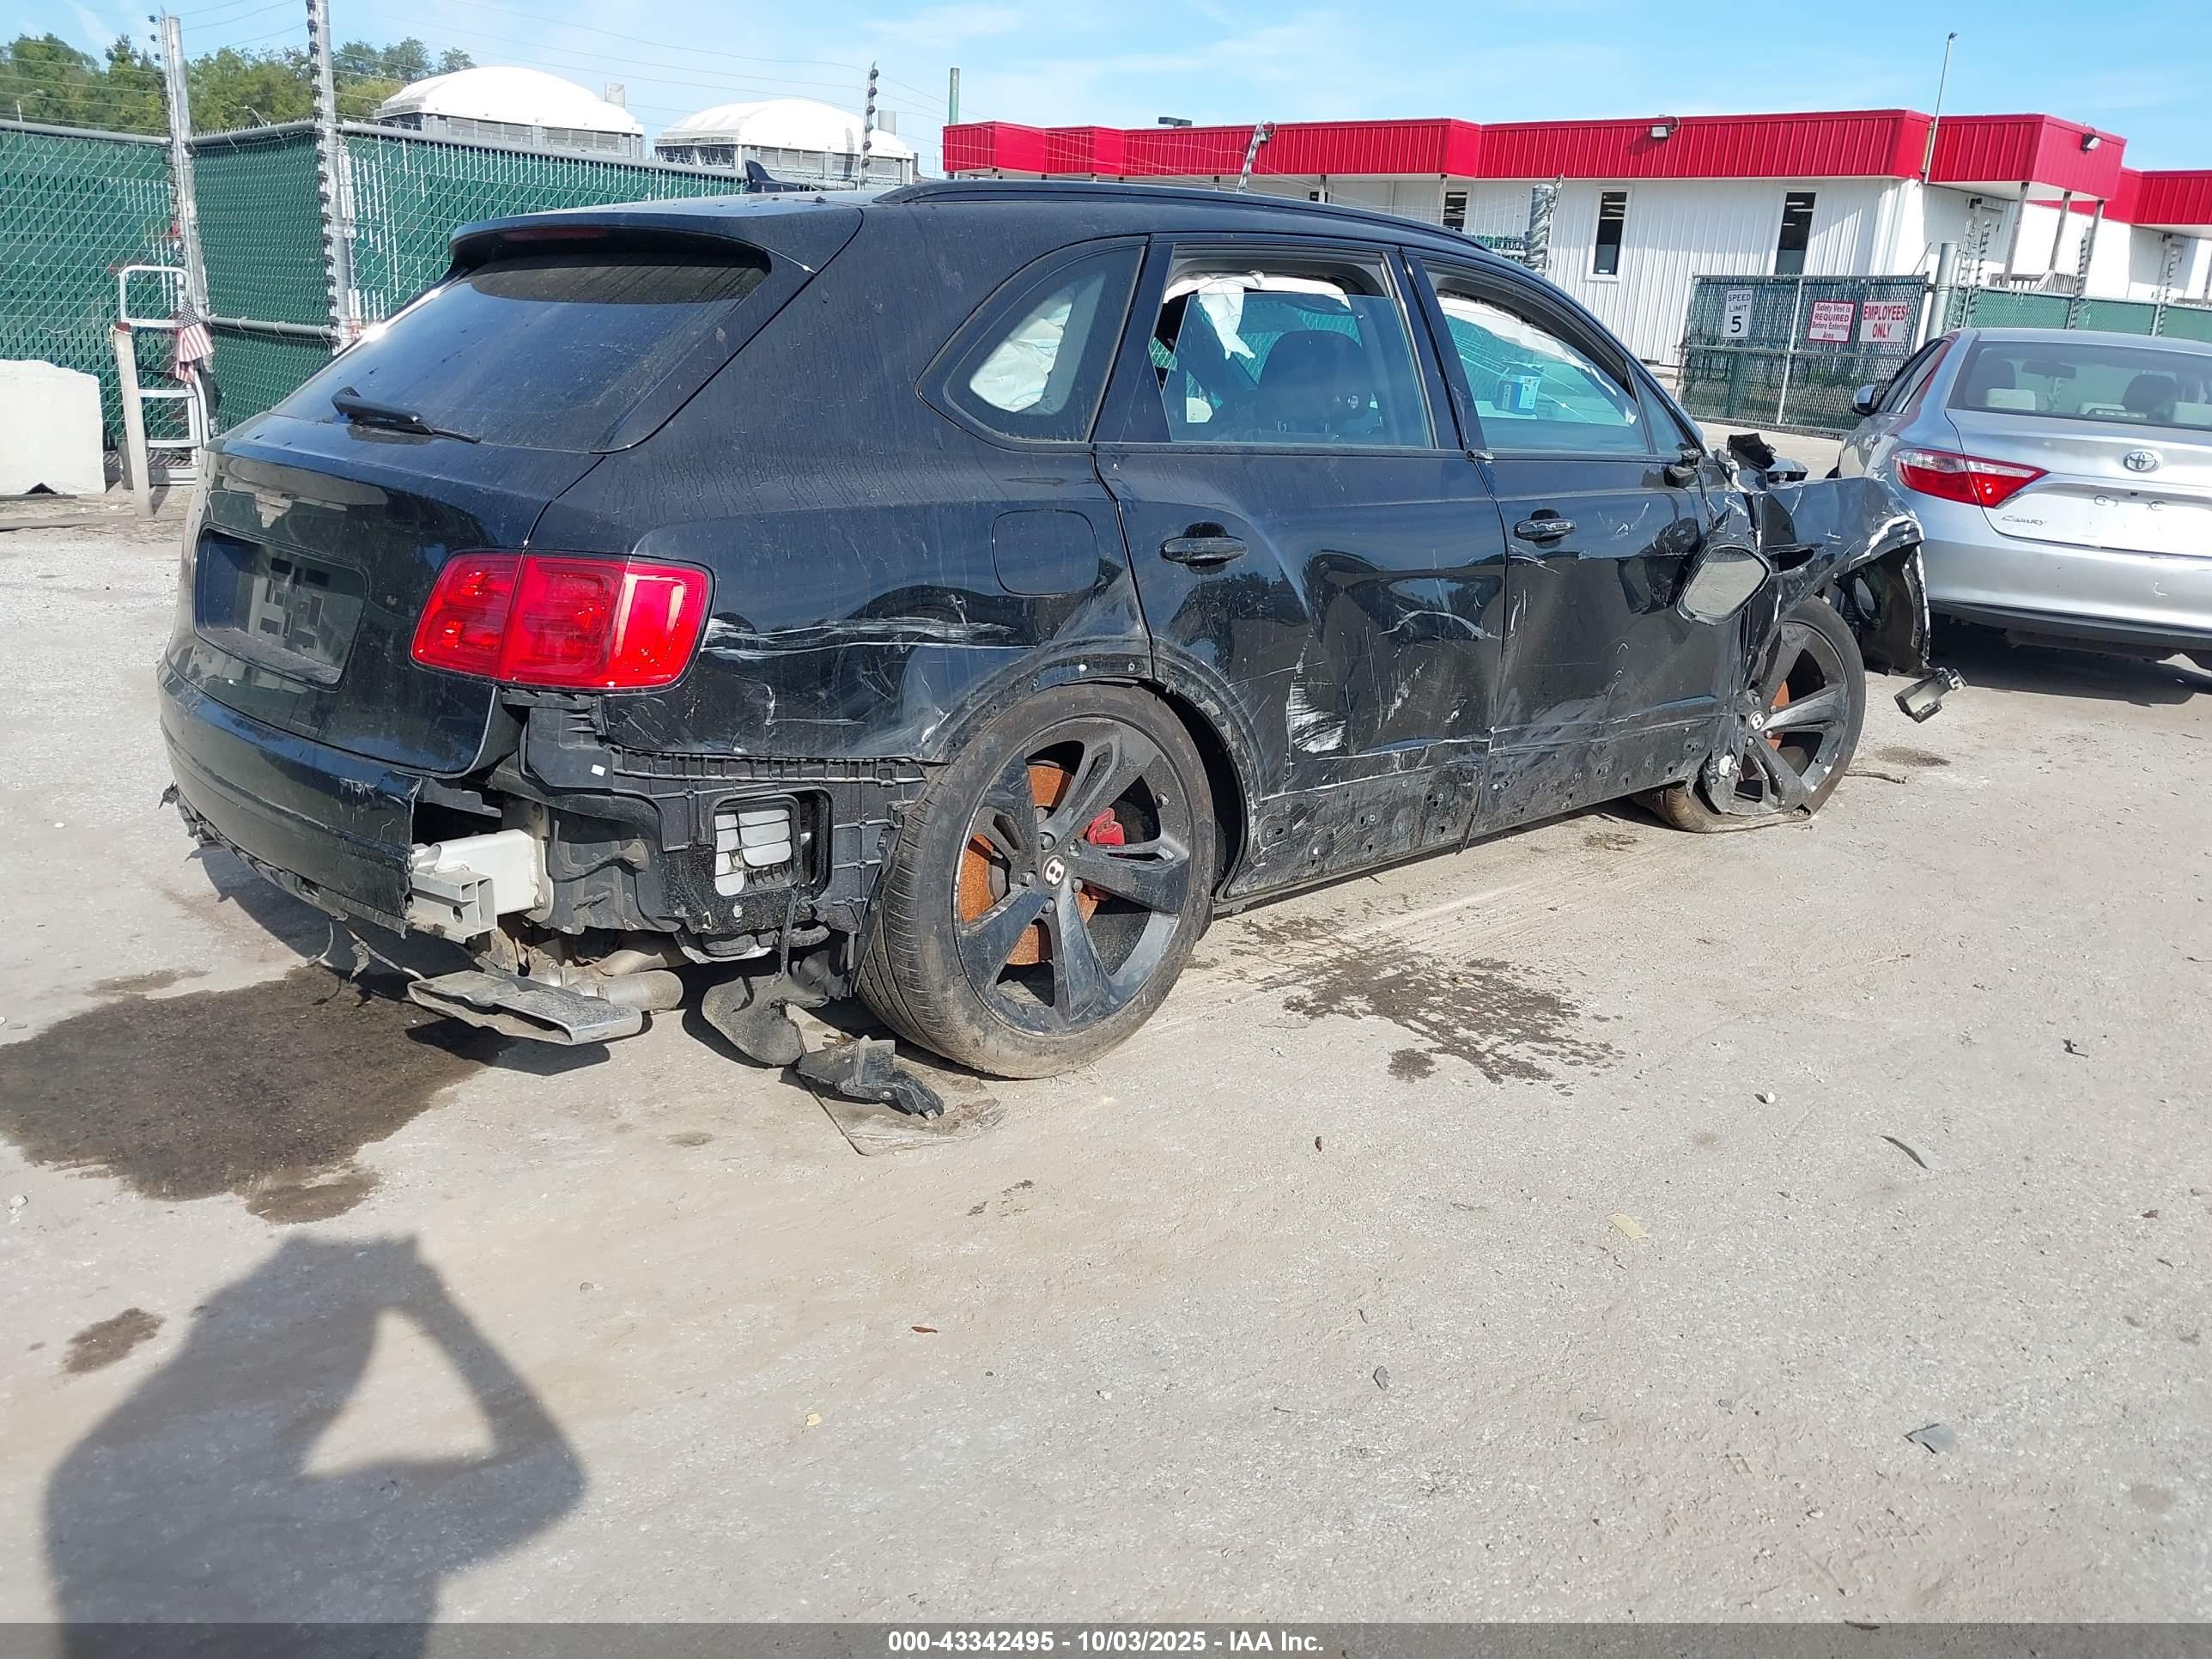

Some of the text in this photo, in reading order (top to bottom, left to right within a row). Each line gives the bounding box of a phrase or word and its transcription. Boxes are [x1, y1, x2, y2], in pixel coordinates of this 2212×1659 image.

[1728, 295, 1752, 303] SPEED
[1816, 303, 1832, 313] Safety
[1833, 304, 1845, 313] Vest
[1863, 305, 1906, 320] EMPLOYEES
[1814, 313, 1850, 322] REQUIRED
[1730, 316, 1742, 334] 5
[1812, 320, 1849, 332] Before Entering
[1872, 322, 1893, 337] ONLY
[1822, 331, 1834, 339] Area
